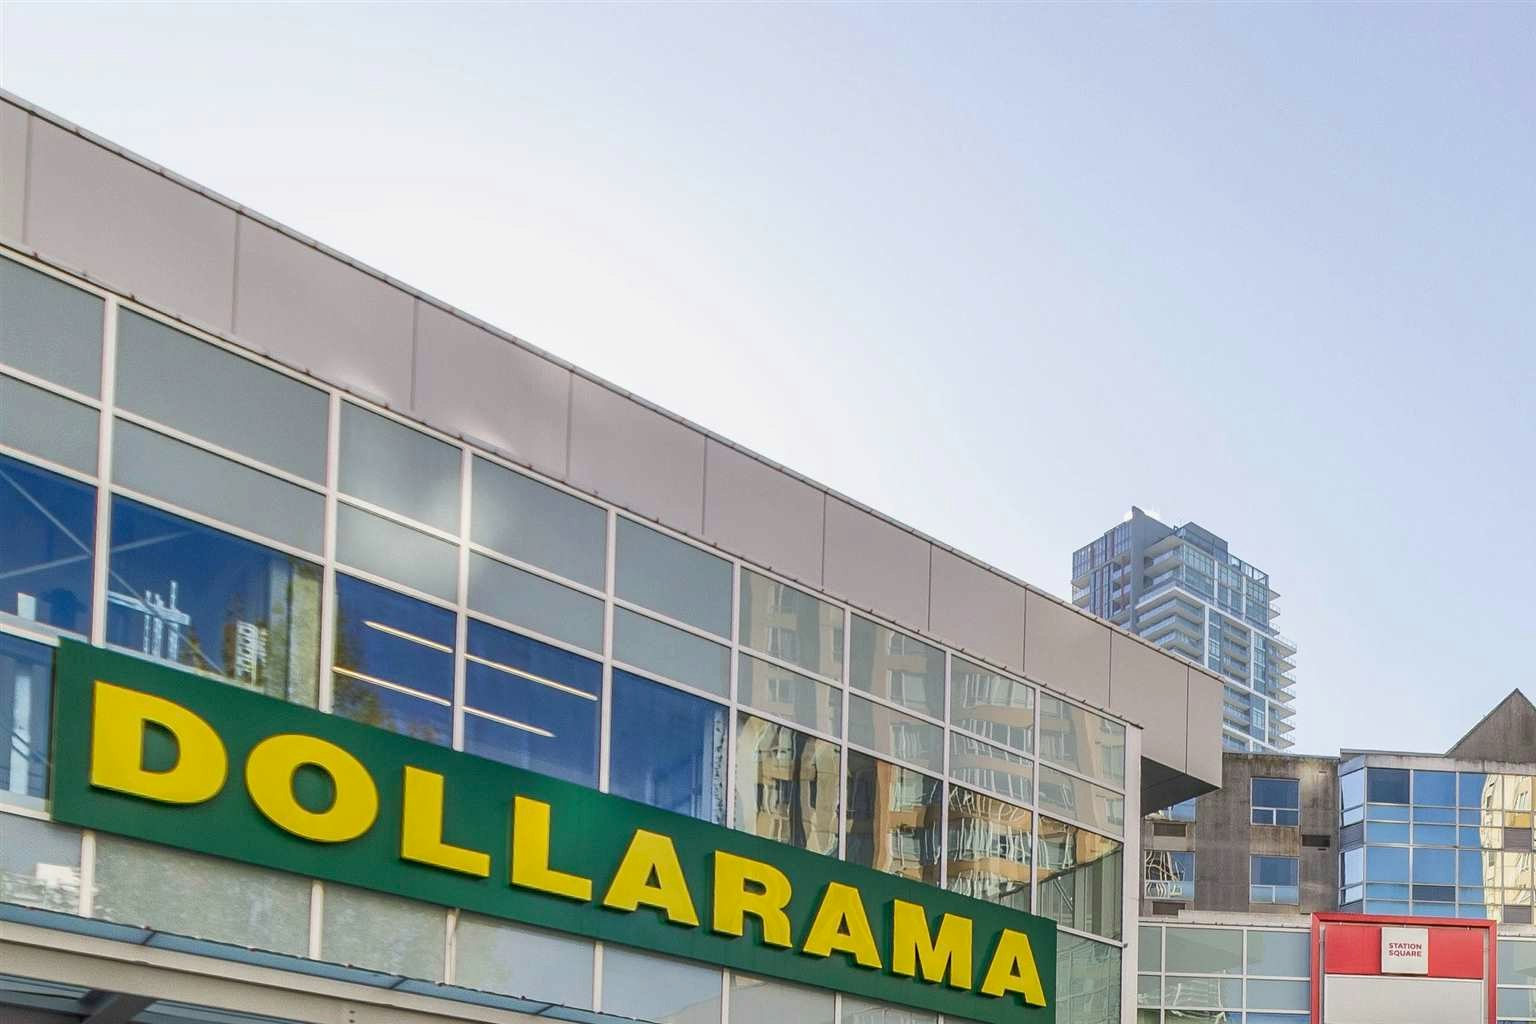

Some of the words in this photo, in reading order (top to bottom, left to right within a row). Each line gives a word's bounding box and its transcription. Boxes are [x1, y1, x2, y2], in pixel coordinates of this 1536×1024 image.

[89, 680, 1047, 1008] DOLLARAMA
[1388, 942, 1422, 950] STATION
[1388, 949, 1422, 957] SQUARE
